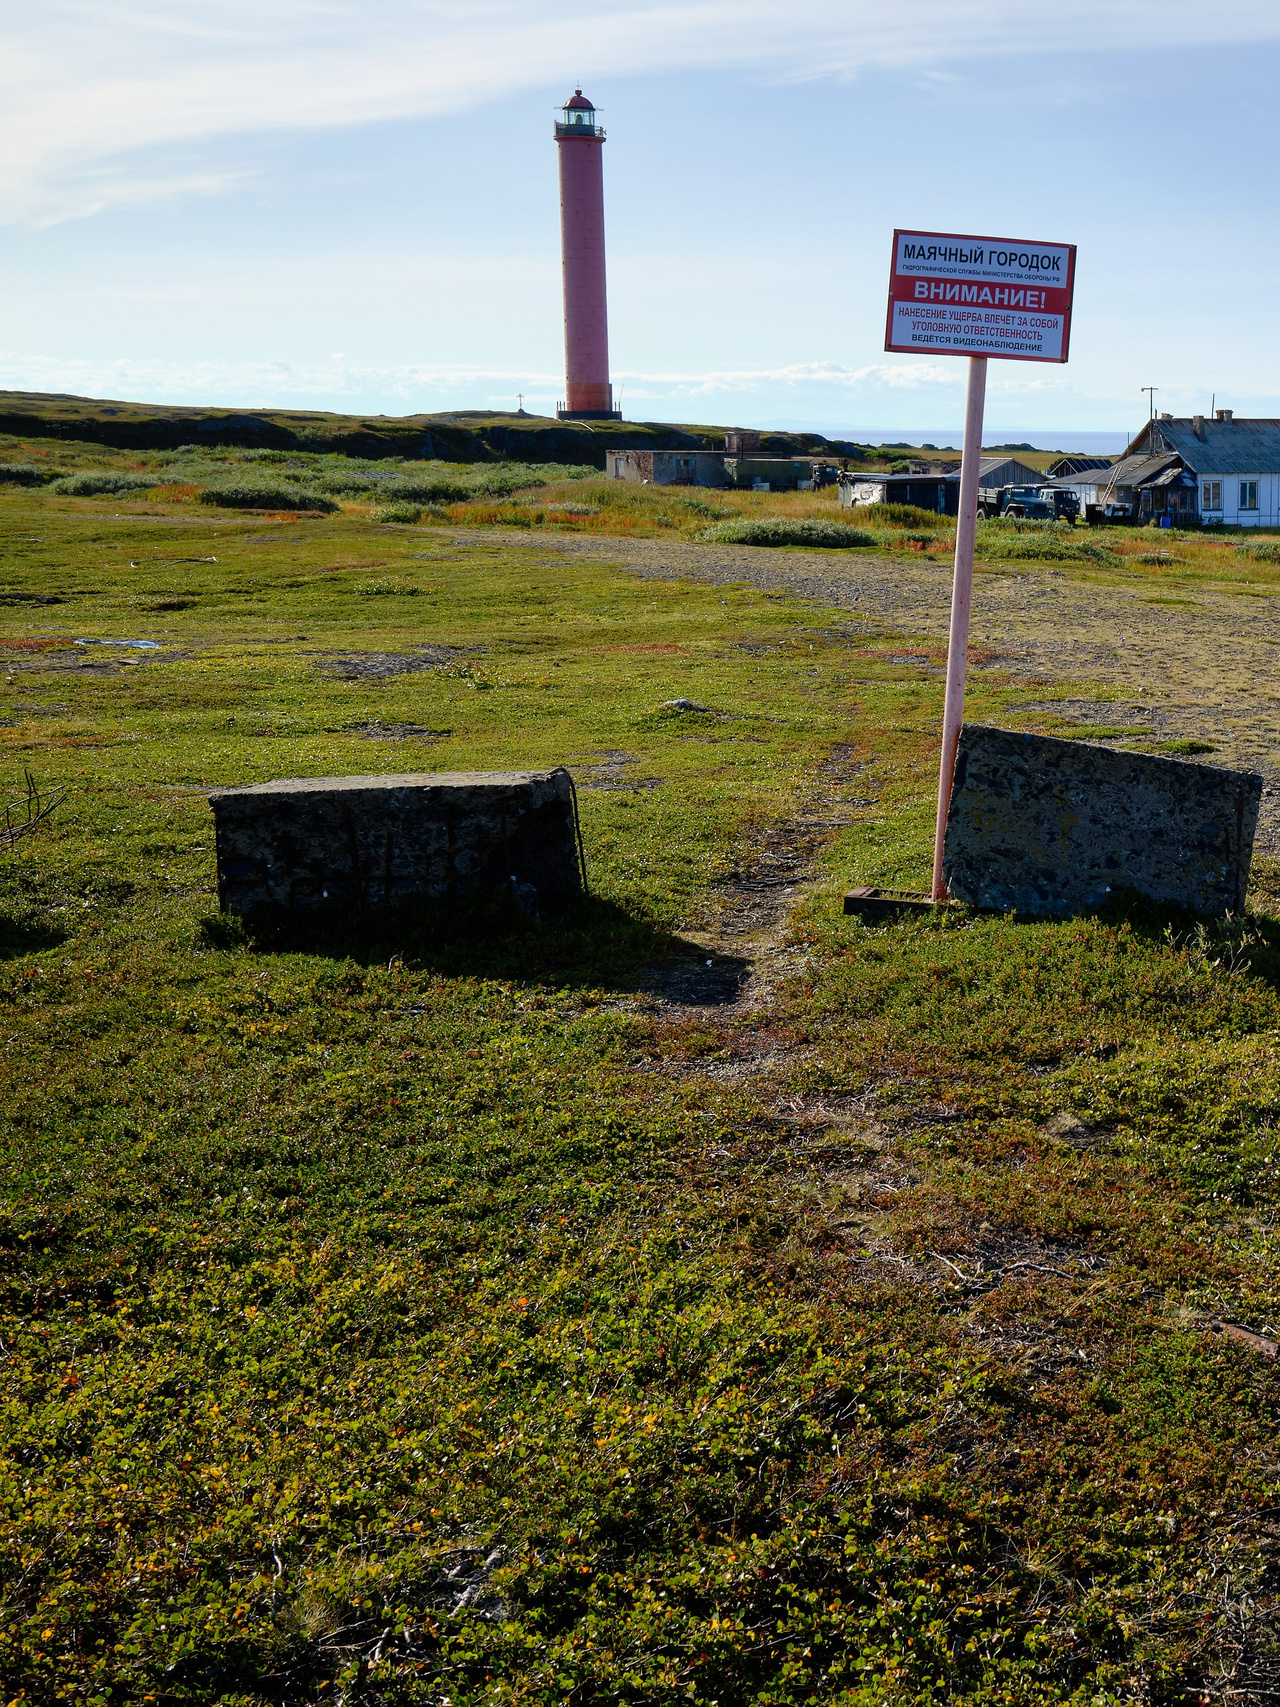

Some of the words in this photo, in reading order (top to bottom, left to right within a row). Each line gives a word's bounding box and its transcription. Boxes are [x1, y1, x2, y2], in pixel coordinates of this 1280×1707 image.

[903, 243, 983, 264] МАЯЧНЫЙ
[988, 250, 1062, 272] ГОРОДОК
[902, 264, 957, 274] ГИДРОГРАФИЧЕСКОЙ
[958, 268, 982, 276] СЛУЖБЫ
[982, 270, 1023, 279] МИНИСТЕРСТВА
[1024, 273, 1051, 282] ОБОРОНЫ
[914, 281, 1046, 309] ВНИМАНИЕ!
[898, 307, 947, 320] НАНЕСЕНИЕ
[948, 310, 982, 323] УЩЕРБА
[984, 312, 1016, 326] ВЛЕЧЁТ
[1017, 316, 1028, 326] ЗА
[1030, 317, 1059, 330] СОБОЙ
[912, 321, 962, 334] УГОЛОВНУЮ
[963, 325, 1043, 341] ОТВЕТСТВЕННОСТЬ
[912, 334, 951, 344] ВЕДЁТСЯ
[953, 336, 1043, 352] ВИДЕОНАБЛЮДЕНИЕ
